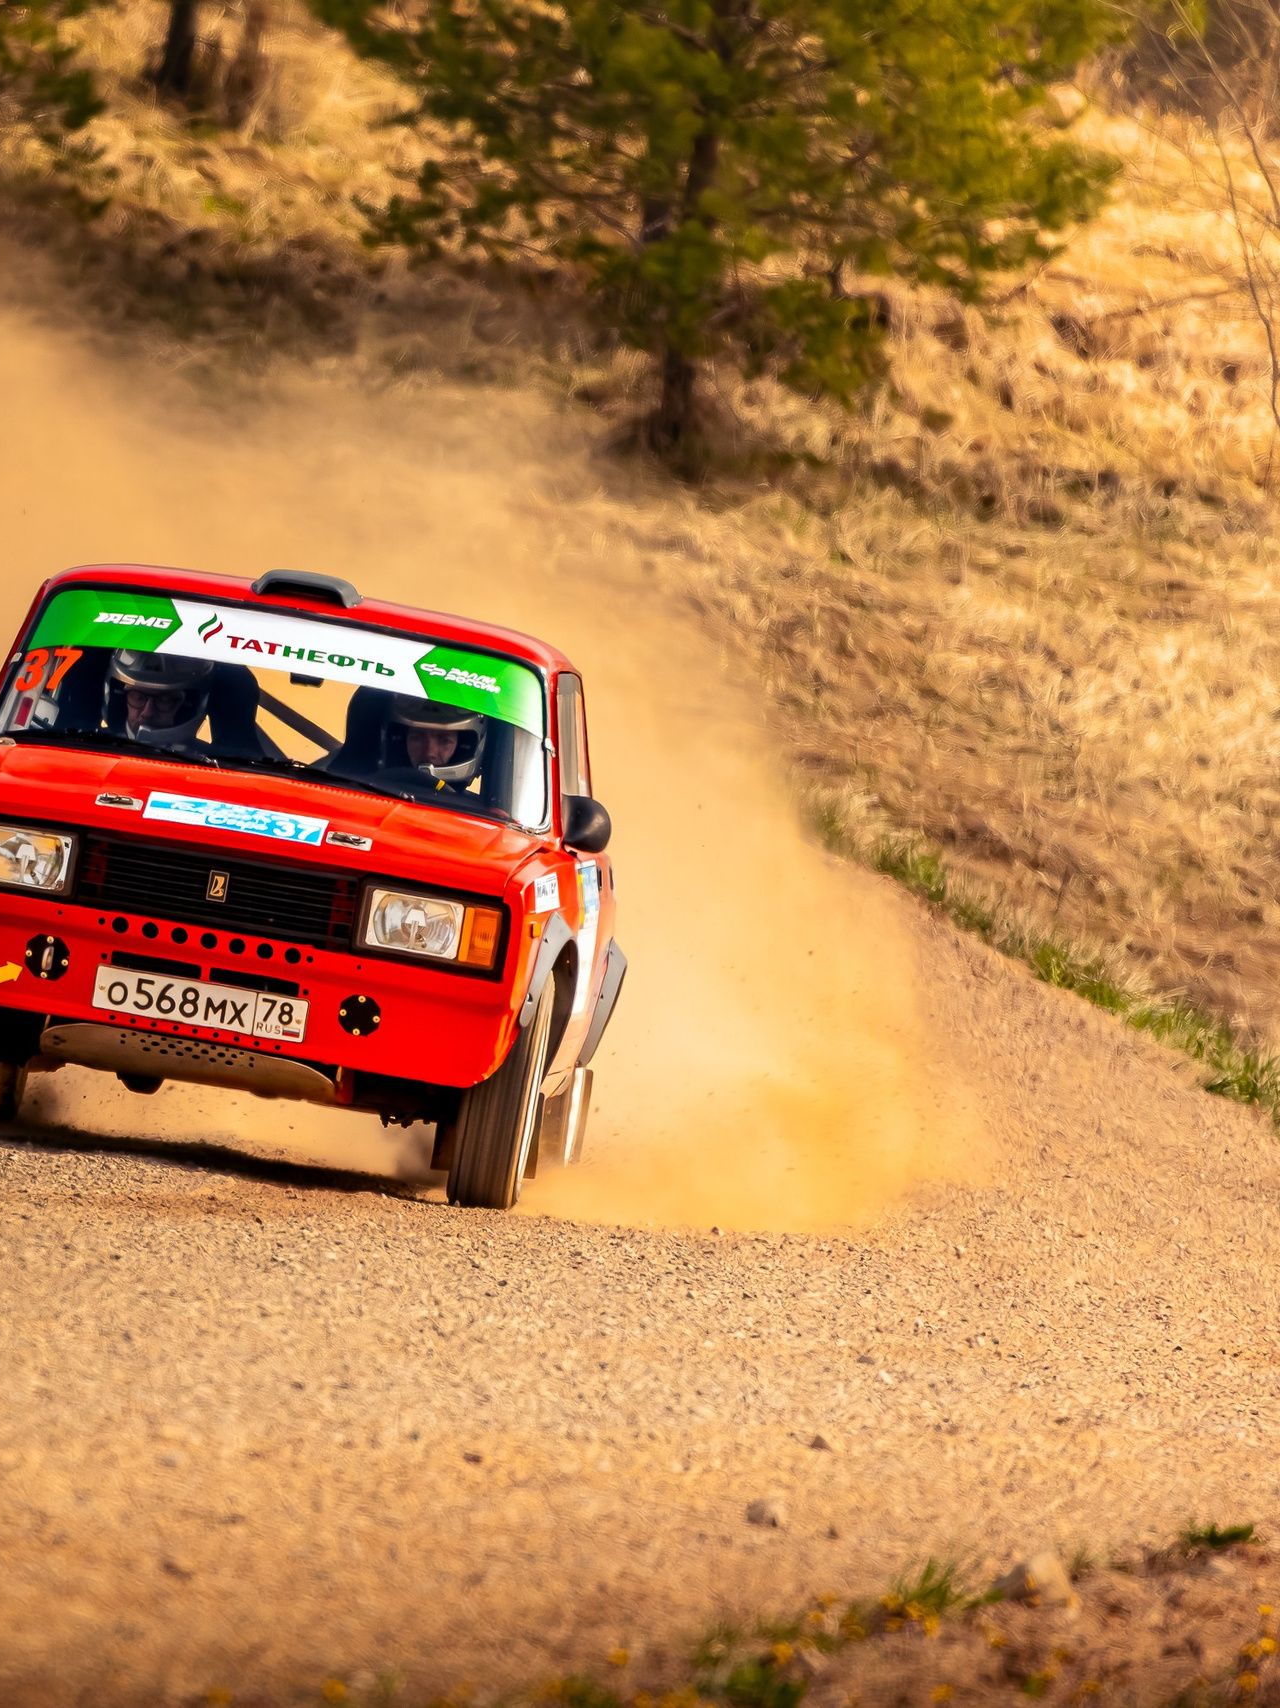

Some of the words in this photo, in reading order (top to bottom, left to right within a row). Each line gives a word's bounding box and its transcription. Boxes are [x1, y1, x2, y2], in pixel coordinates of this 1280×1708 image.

[15, 648, 83, 692] 37
[227, 635, 395, 677] ТАТНЕФТЬ
[273, 820, 321, 841] 37
[262, 998, 294, 1026] 78
[255, 1022, 282, 1035] RUS
